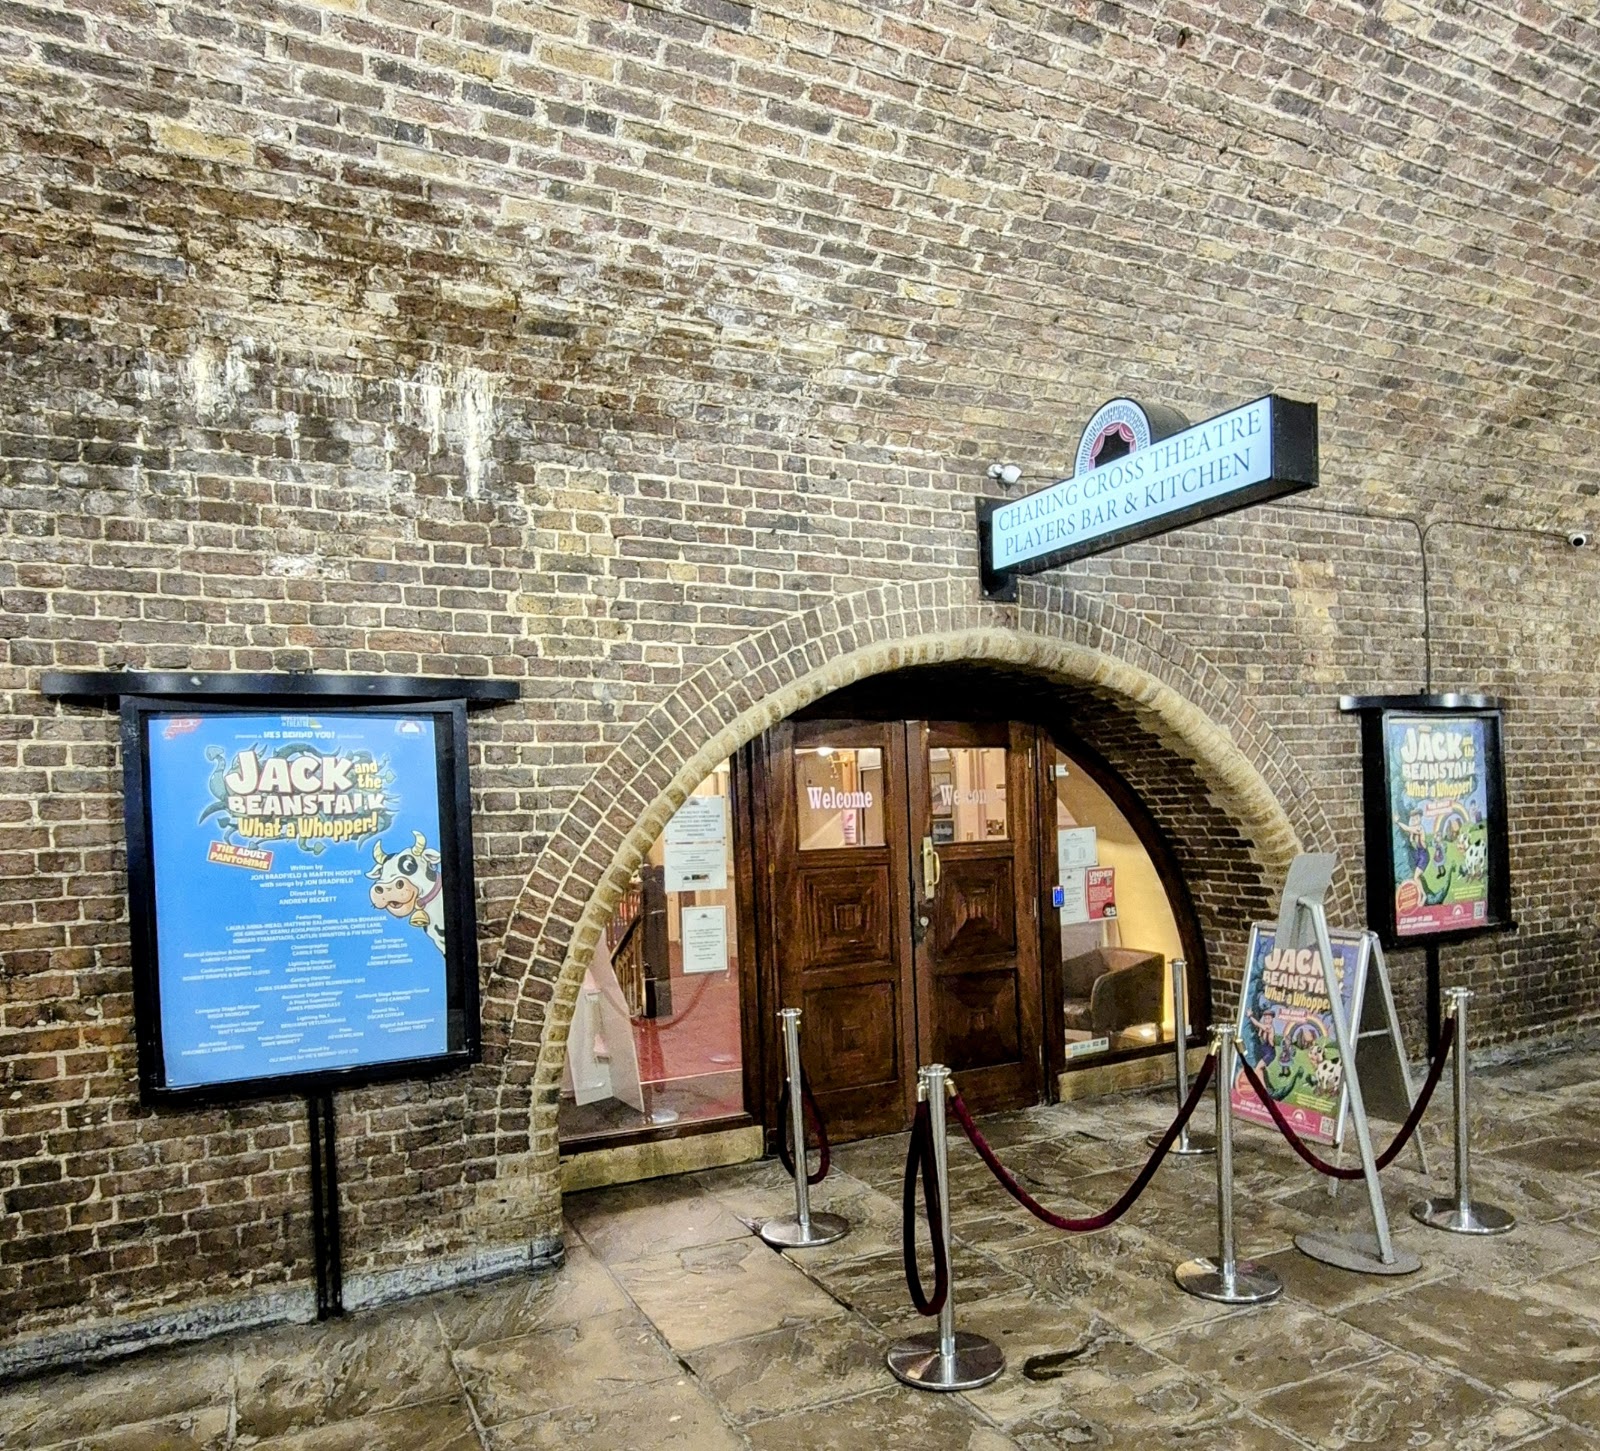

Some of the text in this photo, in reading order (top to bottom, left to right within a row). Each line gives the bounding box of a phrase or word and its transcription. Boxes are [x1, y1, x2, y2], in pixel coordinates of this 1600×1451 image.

[998, 407, 1263, 532] CHARING CROSS THEATRE
[1005, 447, 1251, 557] PLAYERS BAR & KITCHEN
[282, 730, 313, 738] BEHIND
[1400, 728, 1463, 763] JACK
[225, 750, 353, 795] JACK
[354, 760, 378, 775] and
[1402, 762, 1475, 780] BEANSTALK
[358, 775, 382, 789] the
[1406, 780, 1429, 798] What
[228, 793, 386, 816] BEANSTALK
[807, 786, 873, 809] Welcome
[237, 817, 377, 843] What a Whopper!
[210, 852, 269, 869] PANTOMIME
[216, 844, 267, 860] THE ADULT
[265, 872, 302, 880] BRADFIELD
[1089, 870, 1113, 878] UNDER
[1106, 908, 1116, 916] 25
[1264, 986, 1330, 1014] What a Whoppe
